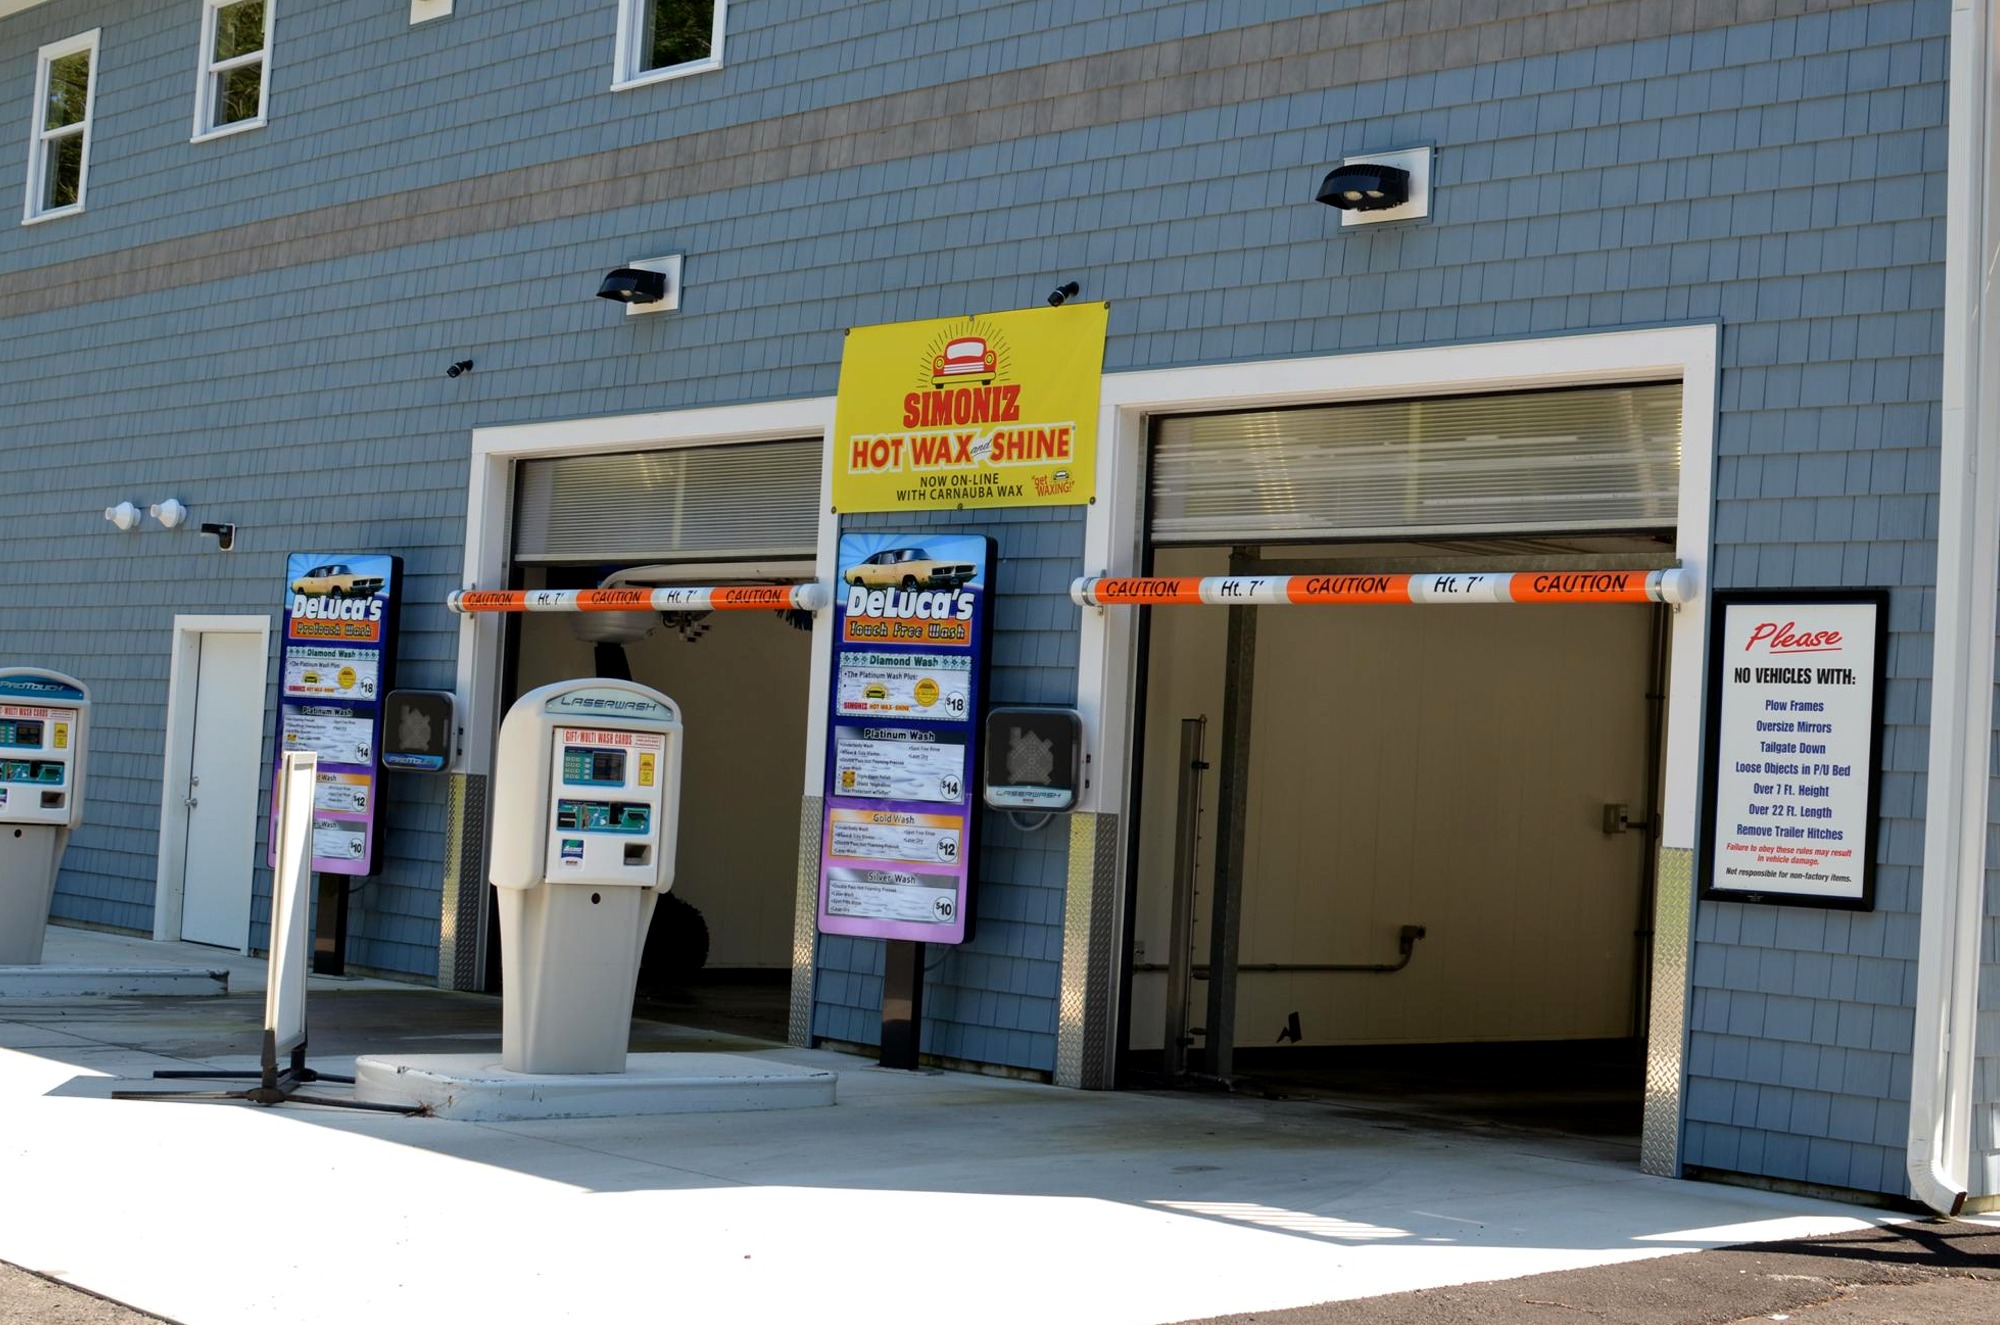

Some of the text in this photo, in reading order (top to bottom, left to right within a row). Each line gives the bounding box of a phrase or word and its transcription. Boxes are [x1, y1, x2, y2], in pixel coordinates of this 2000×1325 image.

[903, 384, 1021, 428] SIMONIZ
[852, 428, 1070, 468] HOT WAX and SHINE
[920, 473, 999, 487] NOW ON-LINE
[897, 485, 1023, 501] WITH CARNAUBA WAX
[1106, 581, 1180, 597] CAUTION
[1220, 581, 1242, 597] Ht.
[1306, 577, 1389, 595] CAUTION
[1434, 576, 1458, 593] Ht.
[1533, 574, 1629, 593] CAUTION
[468, 592, 513, 606] CAUTION
[591, 590, 640, 605] CAUTION
[726, 588, 782, 604] CAUTION
[846, 586, 975, 620] DeLuca's
[291, 594, 383, 621] DeLuca's
[851, 621, 965, 639] Touch Free Wash
[1745, 621, 1843, 652] Please
[308, 649, 356, 658] Diamond Wash
[869, 655, 938, 667] Diamond Wash
[859, 671, 885, 679] Platinum
[887, 672, 901, 680] Wash
[1734, 667, 1856, 685] NO VEHICLES WITH:
[561, 698, 657, 711] LASERWASH
[947, 698, 964, 711] $18
[1765, 699, 1824, 712] Plow Frames
[1757, 720, 1832, 733] Oversize Mirrors
[865, 729, 935, 741] Platinum Wash
[1760, 741, 1826, 754] Tailgate Down
[1736, 761, 1851, 777] Loose Objects in P/U Bed
[942, 781, 958, 795] $14
[1754, 783, 1829, 798] Over 7 Ft. Height
[1749, 803, 1832, 819] Over 22 Ft. Length
[873, 813, 915, 825] Gold Wash
[1737, 823, 1843, 840] Remove Trailer Hitches
[939, 843, 956, 856] $12
[1726, 842, 1852, 857] Failure to obey these rules may result
[1757, 854, 1819, 866] in vehicle damage.
[895, 874, 916, 885] Wash
[1725, 867, 1852, 883] Not responsible for non-factory items.
[936, 902, 952, 916] $10
